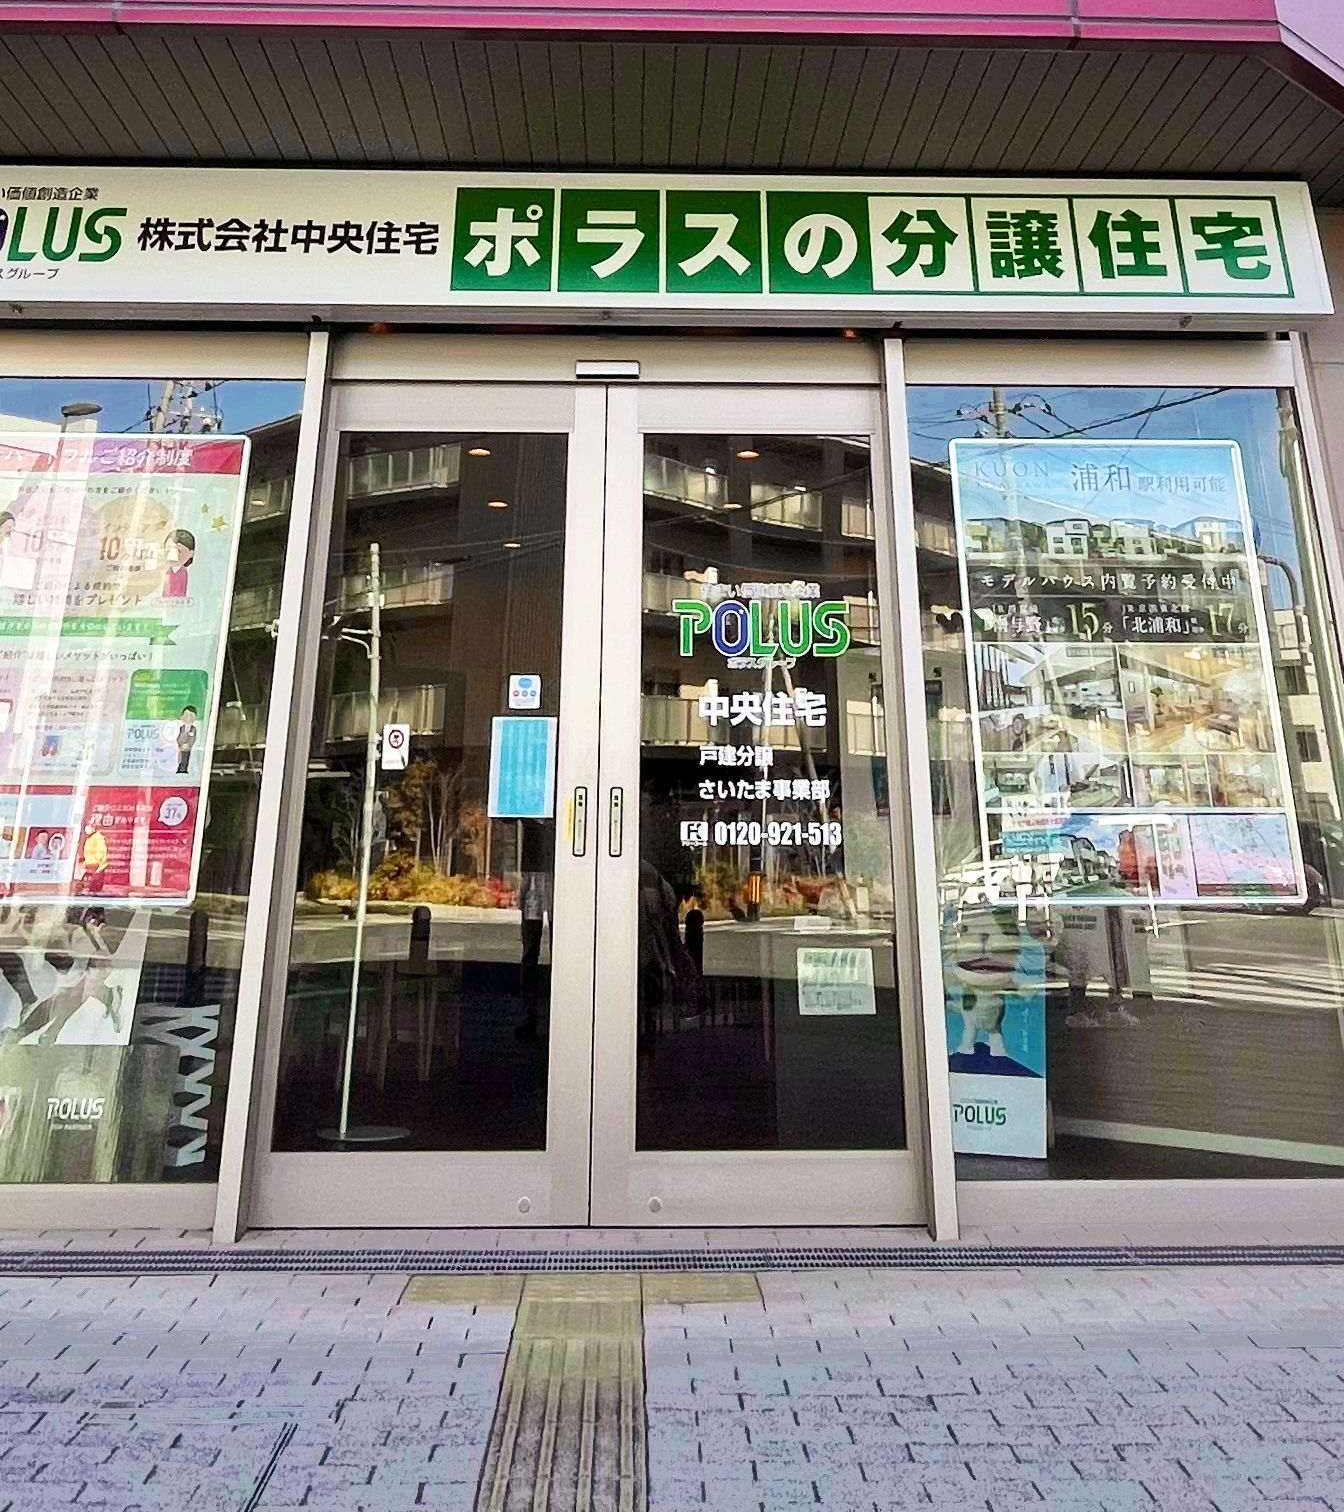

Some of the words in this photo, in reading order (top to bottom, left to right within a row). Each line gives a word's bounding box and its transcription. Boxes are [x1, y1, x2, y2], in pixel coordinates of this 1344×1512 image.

[136, 216, 440, 256] 株式会社中央住宅
[467, 201, 1274, 283] ポラスの分譲住宅
[974, 461, 1049, 478] KUON
[672, 599, 851, 657] POLUS
[698, 690, 828, 727] 中央住宅
[699, 745, 774, 767] 戸建分譲
[698, 778, 831, 800] さいたま事業部
[714, 821, 843, 846] 0120-921-513
[47, 1097, 106, 1120] POLUS
[952, 1103, 1007, 1126] POLUS
